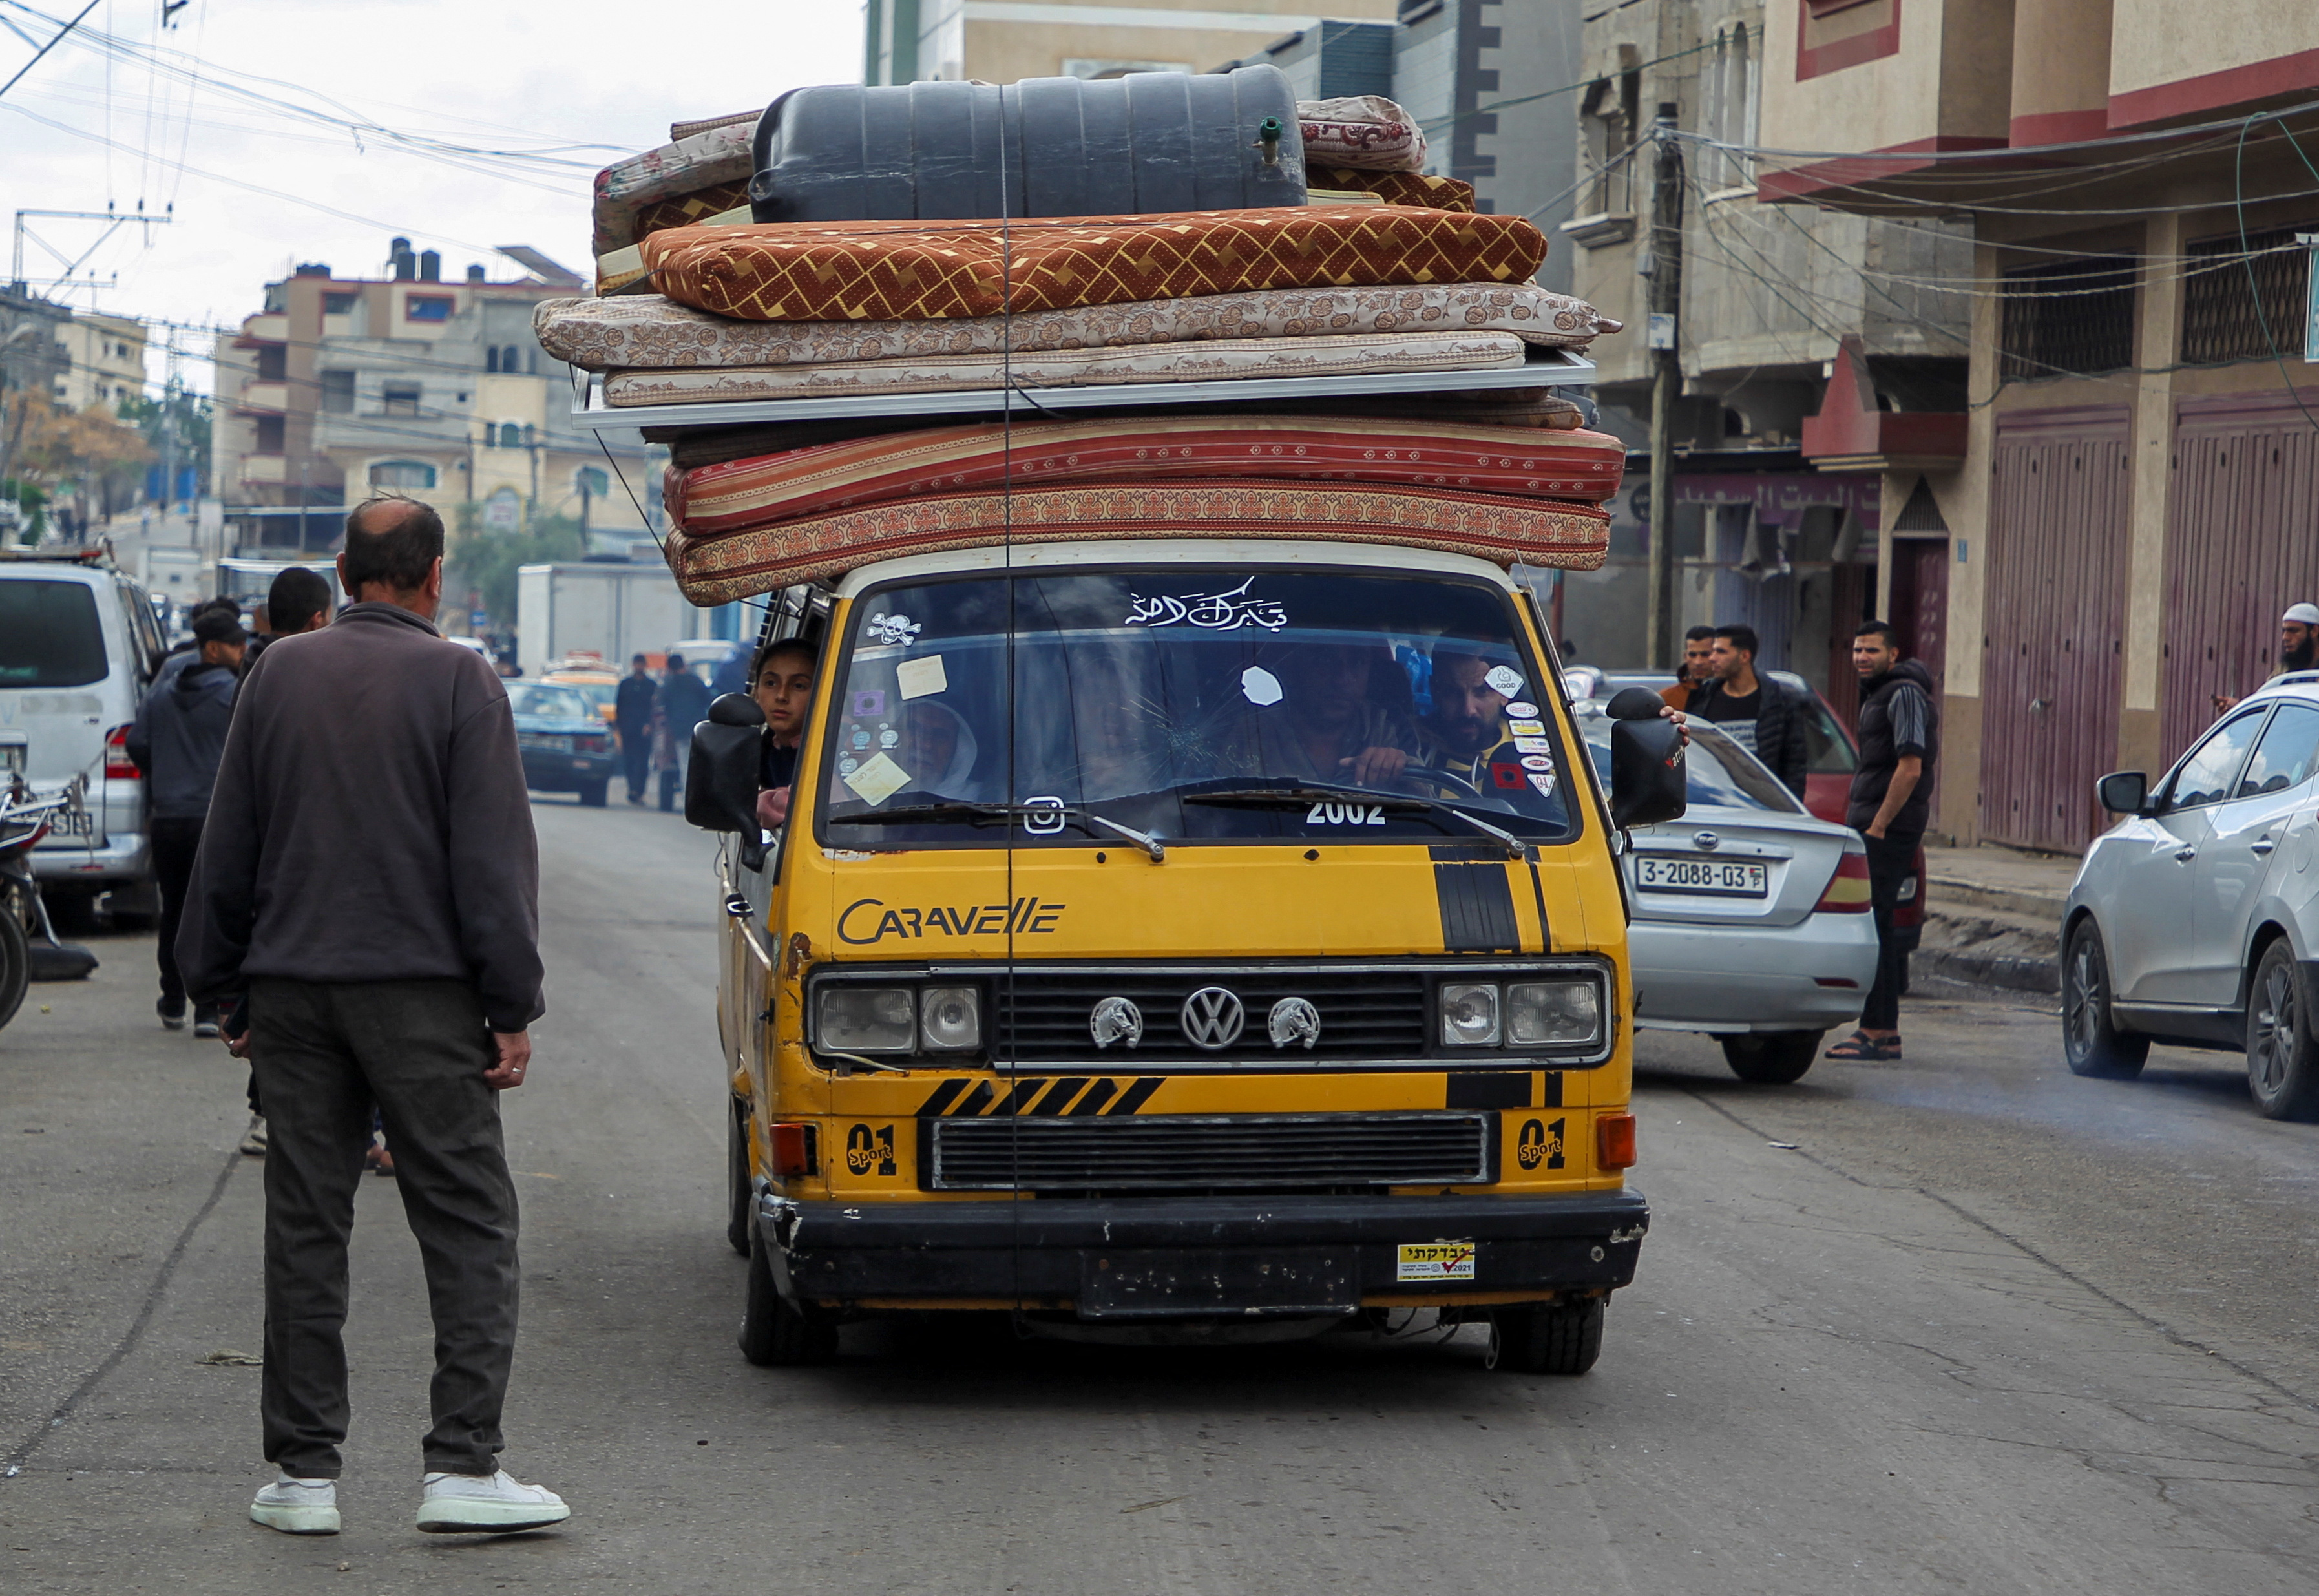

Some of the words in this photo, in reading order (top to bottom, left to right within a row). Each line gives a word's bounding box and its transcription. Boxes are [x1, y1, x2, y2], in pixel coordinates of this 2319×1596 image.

[1306, 801, 1386, 824] 2002
[1644, 861, 1745, 887] 3-2088-03
[1753, 878, 1760, 888] P
[847, 1123, 897, 1176] 01
[1518, 1117, 1566, 1171] 01
[1520, 1139, 1561, 1162] Sport
[849, 1145, 892, 1167] Sport
